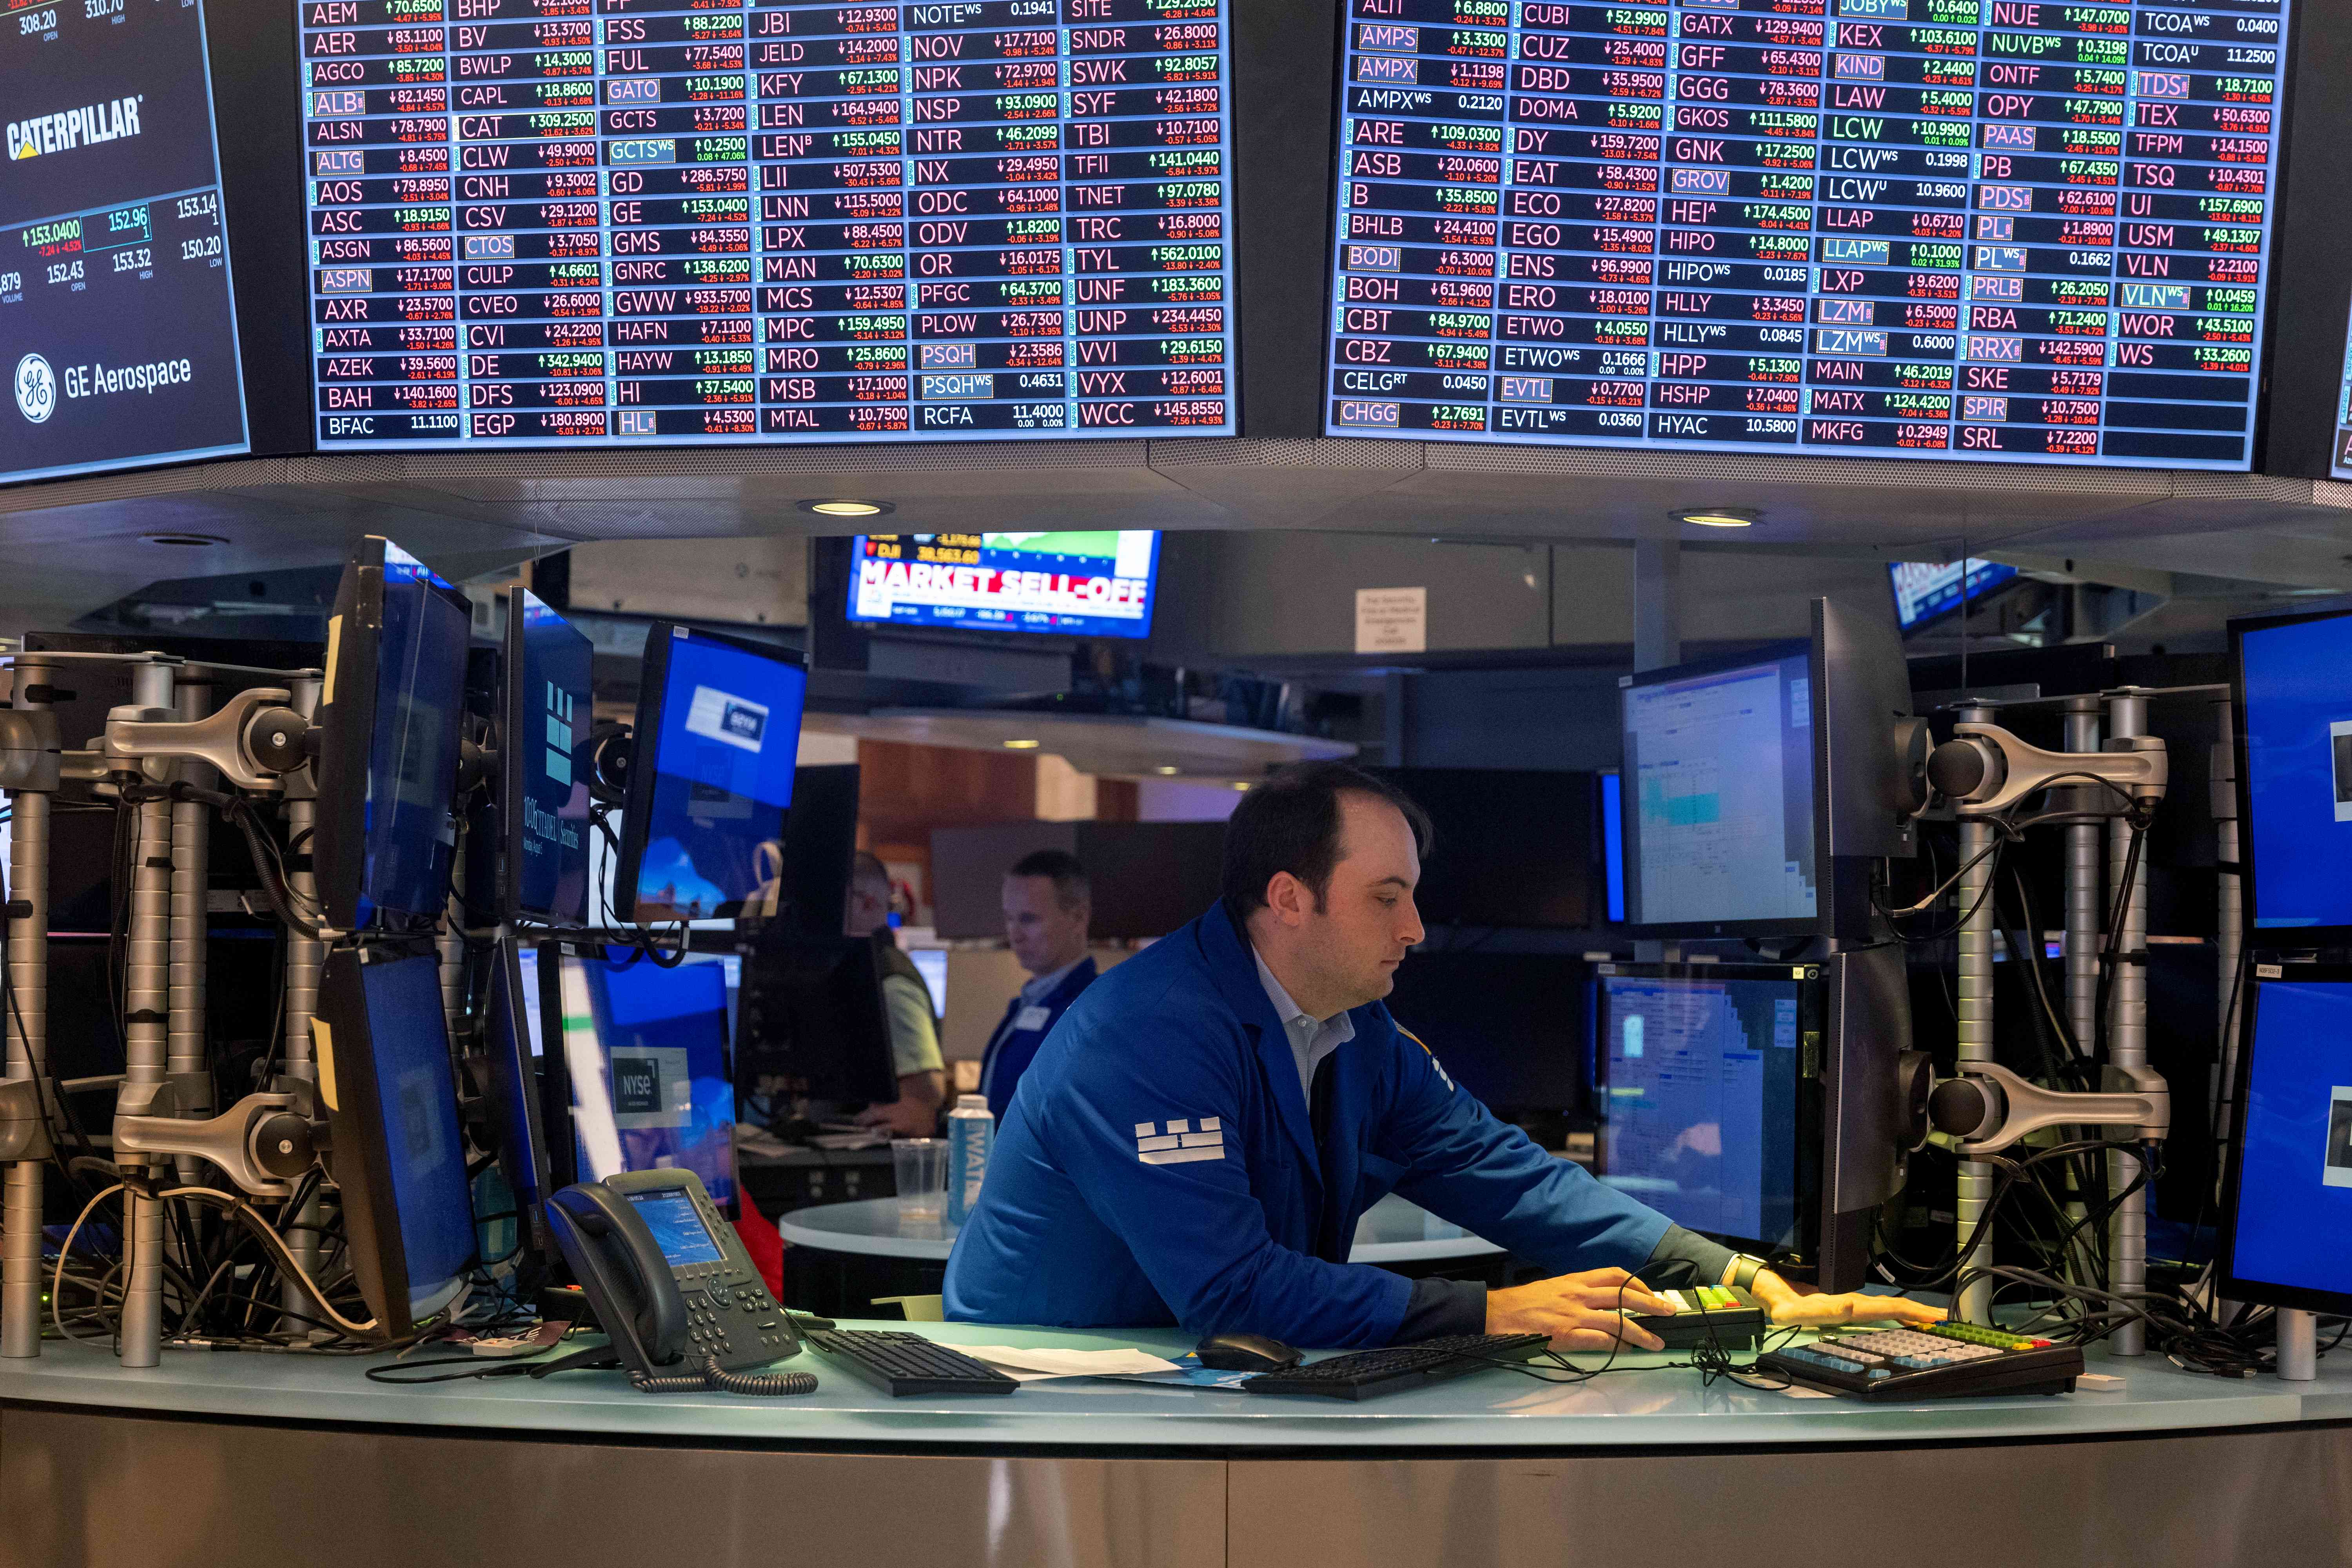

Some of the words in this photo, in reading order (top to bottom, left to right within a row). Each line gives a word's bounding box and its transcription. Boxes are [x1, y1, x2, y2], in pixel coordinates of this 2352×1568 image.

[1011, 1, 1054, 15] 0.1941
[19, 9, 56, 35] 308.20
[112, 14, 125, 25] HIGH
[608, 19, 645, 40] FSS
[693, 15, 742, 30] 88.2200
[1684, 15, 1733, 34] GATX
[1765, 20, 1822, 36] 129.9400
[43, 31, 58, 42] OPEN
[314, 33, 356, 53] AER
[396, 29, 443, 43] 83.1100
[915, 36, 963, 58] NOV
[1005, 32, 1055, 47] 17.7100
[1840, 24, 1882, 46] KEX
[1920, 29, 1976, 45] 103.6100
[395, 44, 413, 53] -3.50
[421, 42, 443, 51] -4.04%
[315, 63, 364, 81] AGCO
[397, 58, 444, 73] 85.7200
[1074, 60, 1126, 83] SWK
[1165, 56, 1217, 71] 92.8057
[1522, 67, 1569, 90] DBD
[1612, 73, 1662, 88] 35.9500
[761, 74, 803, 95] KFY
[848, 70, 898, 84] 67.1300
[690, 92, 708, 100] -1.28
[716, 91, 744, 99] -11.16%
[1074, 93, 1115, 114] SYF
[1165, 89, 1217, 103] 42.1800
[1459, 95, 1502, 110] 0.2120
[1836, 86, 1886, 108] LAW
[1930, 91, 1972, 106] 5.4000
[463, 116, 502, 137] CAT
[539, 113, 593, 127] 309.2500
[2138, 103, 2178, 125] TEX
[2222, 109, 2270, 123] 50.6300
[7, 96, 140, 161] CATERPILLAR
[318, 122, 362, 140] ALSN
[399, 119, 446, 132] 78.7900
[1356, 122, 1404, 143] ARE
[1441, 126, 1500, 142] 109.0300
[464, 146, 509, 167] CLW
[547, 143, 594, 157] 49.9000
[1447, 141, 1466, 149] -4.33
[1475, 142, 1499, 151] -3.82%
[1676, 139, 1724, 161] GNK
[1765, 144, 1815, 159] 17.2500
[918, 161, 949, 182] NX
[1007, 158, 1058, 172] 29.4950
[1075, 156, 1107, 173] TFII
[1159, 152, 1219, 166] 141.0440
[1516, 162, 1559, 183] EAT
[1606, 166, 1657, 181] 58.4300
[613, 172, 642, 192] GD
[690, 168, 746, 183] 286.5750
[764, 167, 786, 187] LII
[843, 163, 900, 177] 507.5300
[320, 181, 362, 202] AOS
[401, 179, 448, 192] 79.8950
[177, 194, 217, 219] 153.14
[2131, 194, 2151, 215] UI
[2208, 198, 2263, 214] 157.6900
[109, 207, 148, 232] 152.96
[213, 212, 219, 225] 1
[30, 220, 80, 246] 153.0400
[144, 226, 149, 238] 1
[39, 246, 55, 257] -7.24
[62, 240, 82, 253] -4.52%
[182, 236, 221, 260] 150.20
[113, 248, 152, 272] 153.32
[210, 258, 222, 268] LOW
[47, 260, 84, 284] 152.43
[140, 270, 153, 280] HIGH
[468, 267, 513, 283] CULP
[558, 264, 599, 277] 4.6601
[2, 292, 23, 304] VOLUME
[71, 282, 86, 292] OPEN
[1349, 278, 1398, 300] BOH
[1441, 283, 1492, 297] 61.9600
[1509, 285, 1555, 307] ERO
[1599, 290, 1649, 305] 18.0100
[617, 291, 675, 312] GWW
[694, 290, 750, 303] 933.5700
[1080, 311, 1126, 332] UNP
[1162, 309, 1221, 323] 234.4450
[2122, 314, 2174, 336] WOR
[2205, 318, 2252, 333] 43.5100
[770, 348, 818, 369] MRO
[856, 347, 906, 361] 25.8600
[1346, 340, 1391, 362] CBZ
[1437, 345, 1488, 359] 67.9400
[327, 359, 373, 376] AZEK
[409, 357, 455, 370] 39.5600
[472, 356, 499, 375] DE
[548, 354, 602, 367] 342.9400
[580, 367, 602, 376] -3.06%
[1817, 361, 1863, 379] MAIN
[1903, 365, 1952, 379] 46.2019
[65, 366, 90, 398] GE
[94, 358, 191, 394] Aerospace
[1967, 367, 2009, 388] SKE
[2060, 372, 2101, 386] 5.7179
[621, 383, 639, 402] HI
[705, 380, 753, 393] 37.5400
[2051, 386, 2069, 394] -0.49
[2077, 386, 2100, 395] -7.92%
[771, 410, 819, 427] MTAL
[858, 408, 907, 421] 10.7500
[925, 407, 973, 424] RCFA
[1013, 405, 1063, 418] 11.4000
[1043, 419, 1063, 427] 0.00%
[1081, 403, 1134, 424] WCC
[1164, 402, 1223, 416] 145.8550
[1599, 413, 1642, 426] 0.0360
[330, 417, 374, 434] BFAC
[412, 416, 457, 428] 11.1100
[1659, 416, 1708, 434] HYAC
[1746, 419, 1796, 433] 10.5800
[1963, 427, 2002, 448] SRL
[2056, 431, 2096, 445] 7.2200
[861, 559, 997, 593] MARKET
[1001, 567, 1147, 604] SELL-OFF
[536, 809, 556, 841] CITADEL
